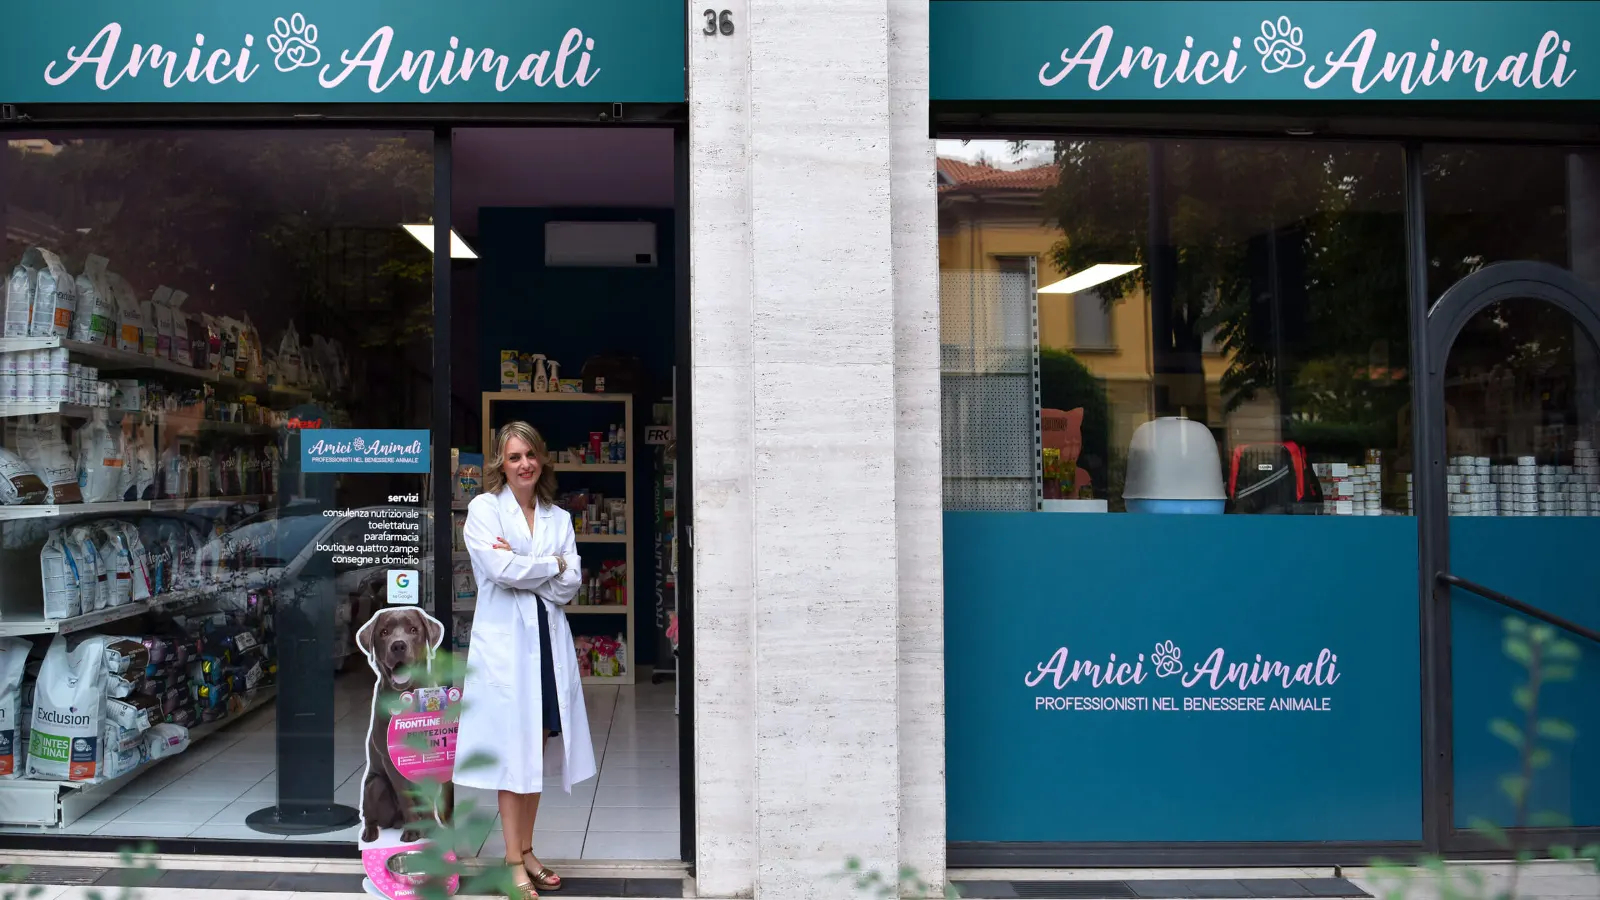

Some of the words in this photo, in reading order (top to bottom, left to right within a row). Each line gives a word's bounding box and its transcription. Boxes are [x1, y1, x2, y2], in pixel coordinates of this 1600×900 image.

[703, 9, 735, 36] 36
[45, 22, 259, 90] Amici
[318, 26, 600, 93] Animali
[1038, 25, 1246, 90] Amici
[1303, 28, 1576, 94] Animali
[308, 440, 352, 455] Amici
[364, 440, 422, 455] Animali
[387, 493, 419, 502] servizi
[322, 507, 369, 518] consulenza
[370, 509, 419, 519] nutrizionale
[368, 520, 419, 530] toelettatura
[364, 531, 419, 543] parafarmacia
[316, 541, 355, 554] boutique
[356, 544, 388, 554] quattro
[389, 547, 419, 555] zampe
[331, 555, 373, 567] consegne
[381, 554, 420, 565] domicilio
[1025, 646, 1147, 690] Amici
[1181, 647, 1340, 690] Animali
[1035, 697, 1148, 710] PROFESSIONISTI
[1152, 697, 1179, 710] NEL
[1183, 697, 1265, 710] BENESSERE
[1269, 697, 1331, 711] ANIMALE
[37, 707, 90, 725] Exclusion
[395, 718, 440, 730] FRONTLINE
[43, 738, 68, 749] INTES
[442, 737, 447, 747] 1
[42, 747, 67, 758] TINAL
